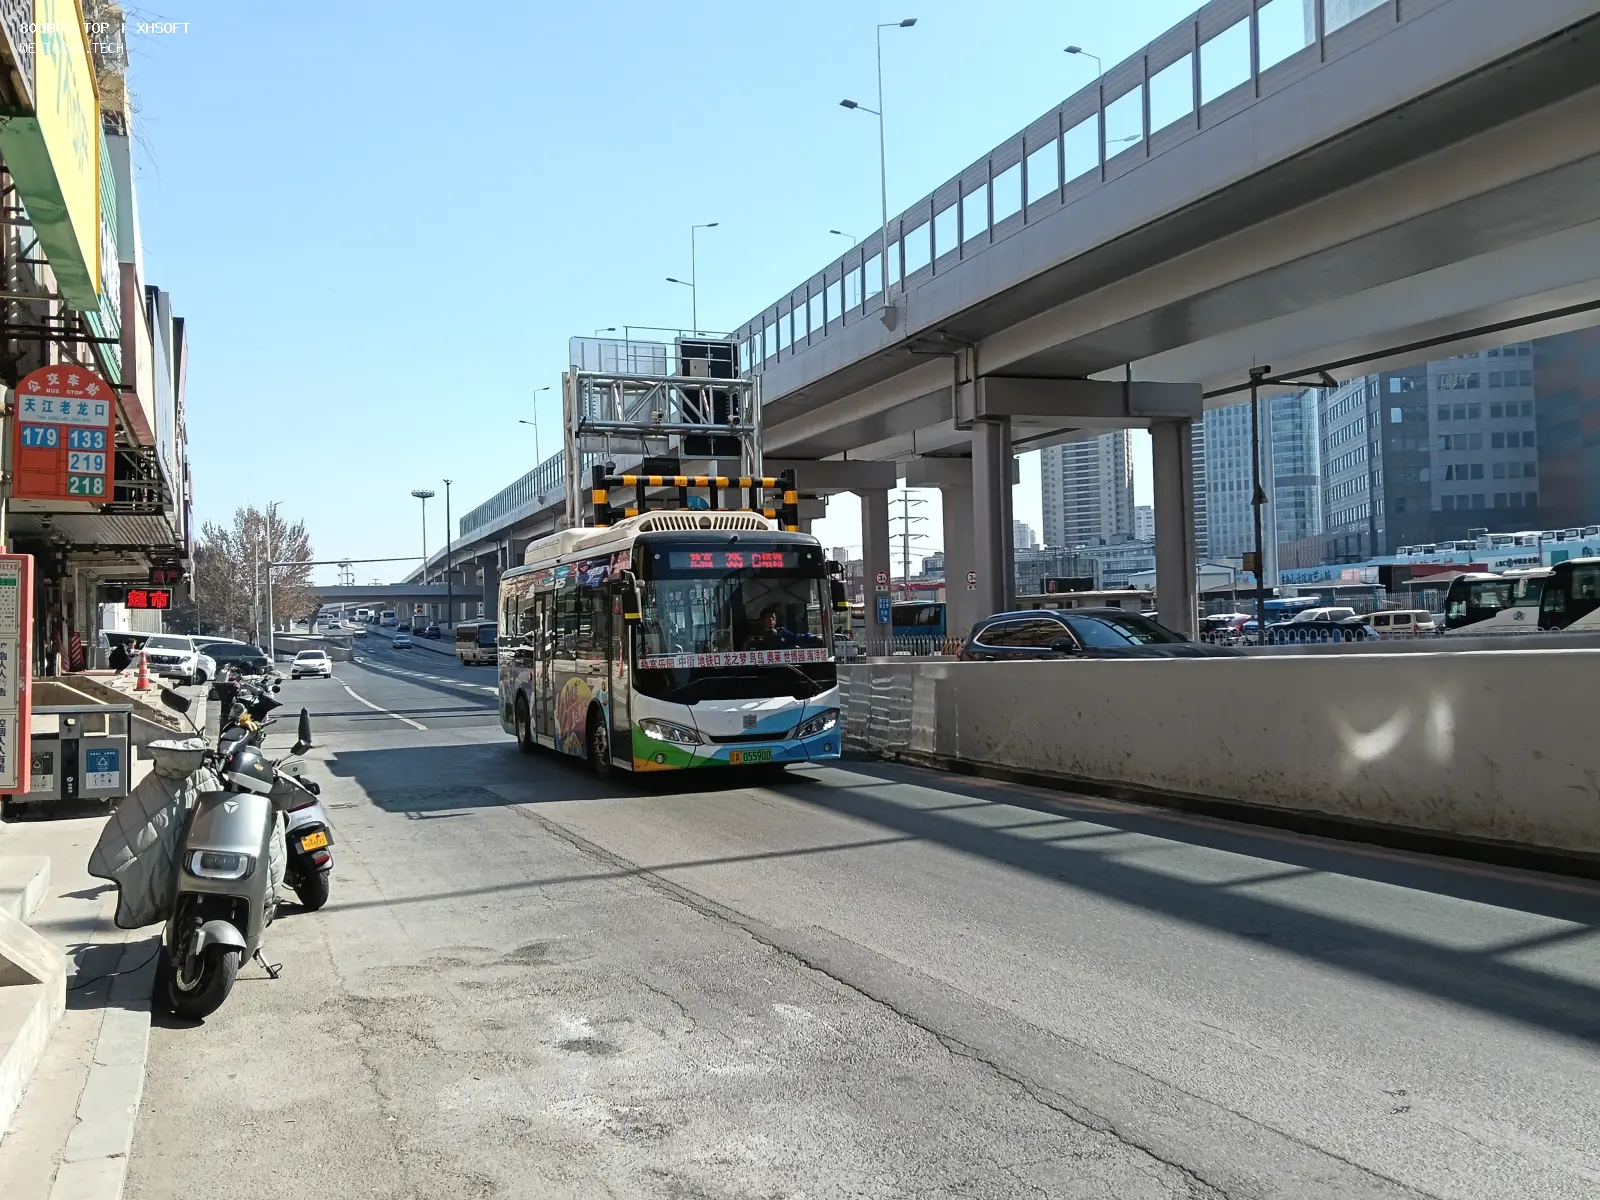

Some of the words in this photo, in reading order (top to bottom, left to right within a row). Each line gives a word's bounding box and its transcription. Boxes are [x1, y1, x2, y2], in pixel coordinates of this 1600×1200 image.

[27, 372, 100, 397] 公交车站
[24, 398, 105, 417] 天江老龙口
[23, 427, 57, 446] 179
[70, 430, 104, 449] 133
[70, 453, 103, 471] 219
[69, 476, 103, 494] 218
[128, 590, 169, 608] 超市
[678, 655, 695, 668] 中街
[697, 654, 721, 667] 地铁口
[724, 652, 747, 665] 龙之梦
[767, 650, 782, 664] 奥莱
[784, 650, 805, 663] 世博园
[806, 649, 827, 662] 海洋馆
